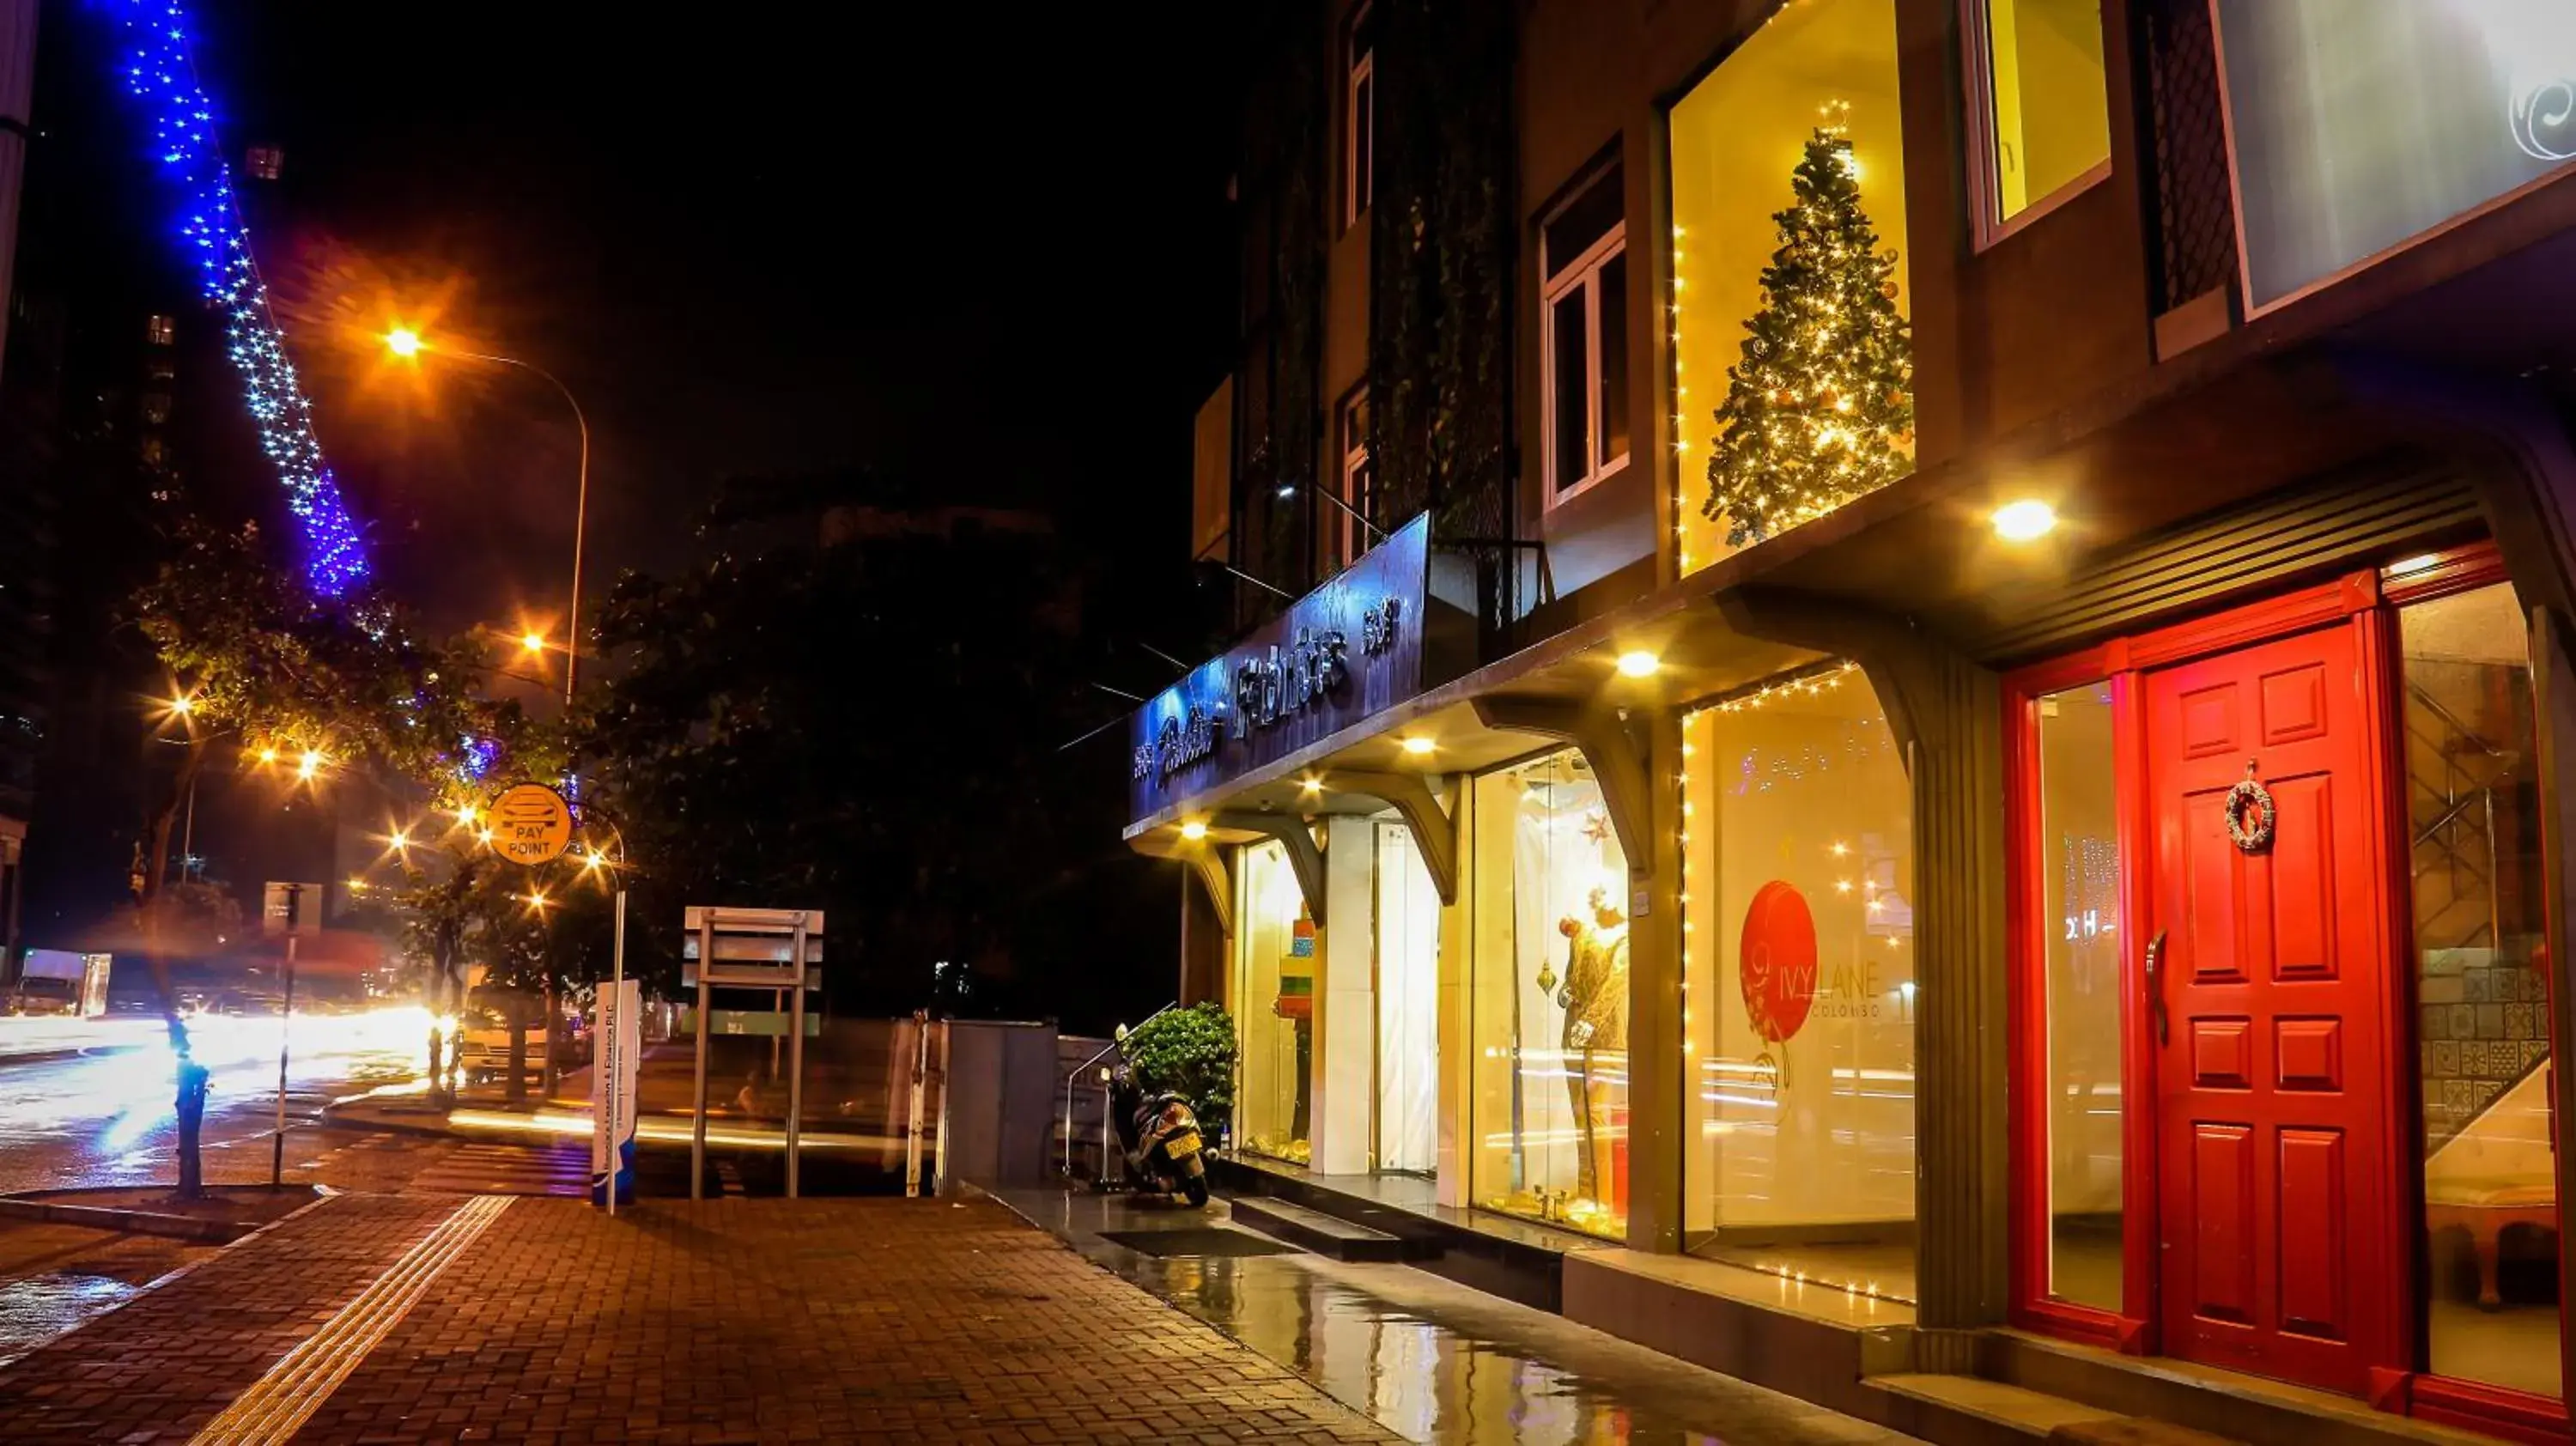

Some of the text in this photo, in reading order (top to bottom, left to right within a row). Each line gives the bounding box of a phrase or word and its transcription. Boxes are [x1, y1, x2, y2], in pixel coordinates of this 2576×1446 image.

[515, 826, 544, 839] PAY
[508, 842, 550, 855] POINT
[1779, 963, 1814, 1001] IVY
[1819, 959, 1880, 1000] LANE
[605, 1003, 614, 1026] PLC
